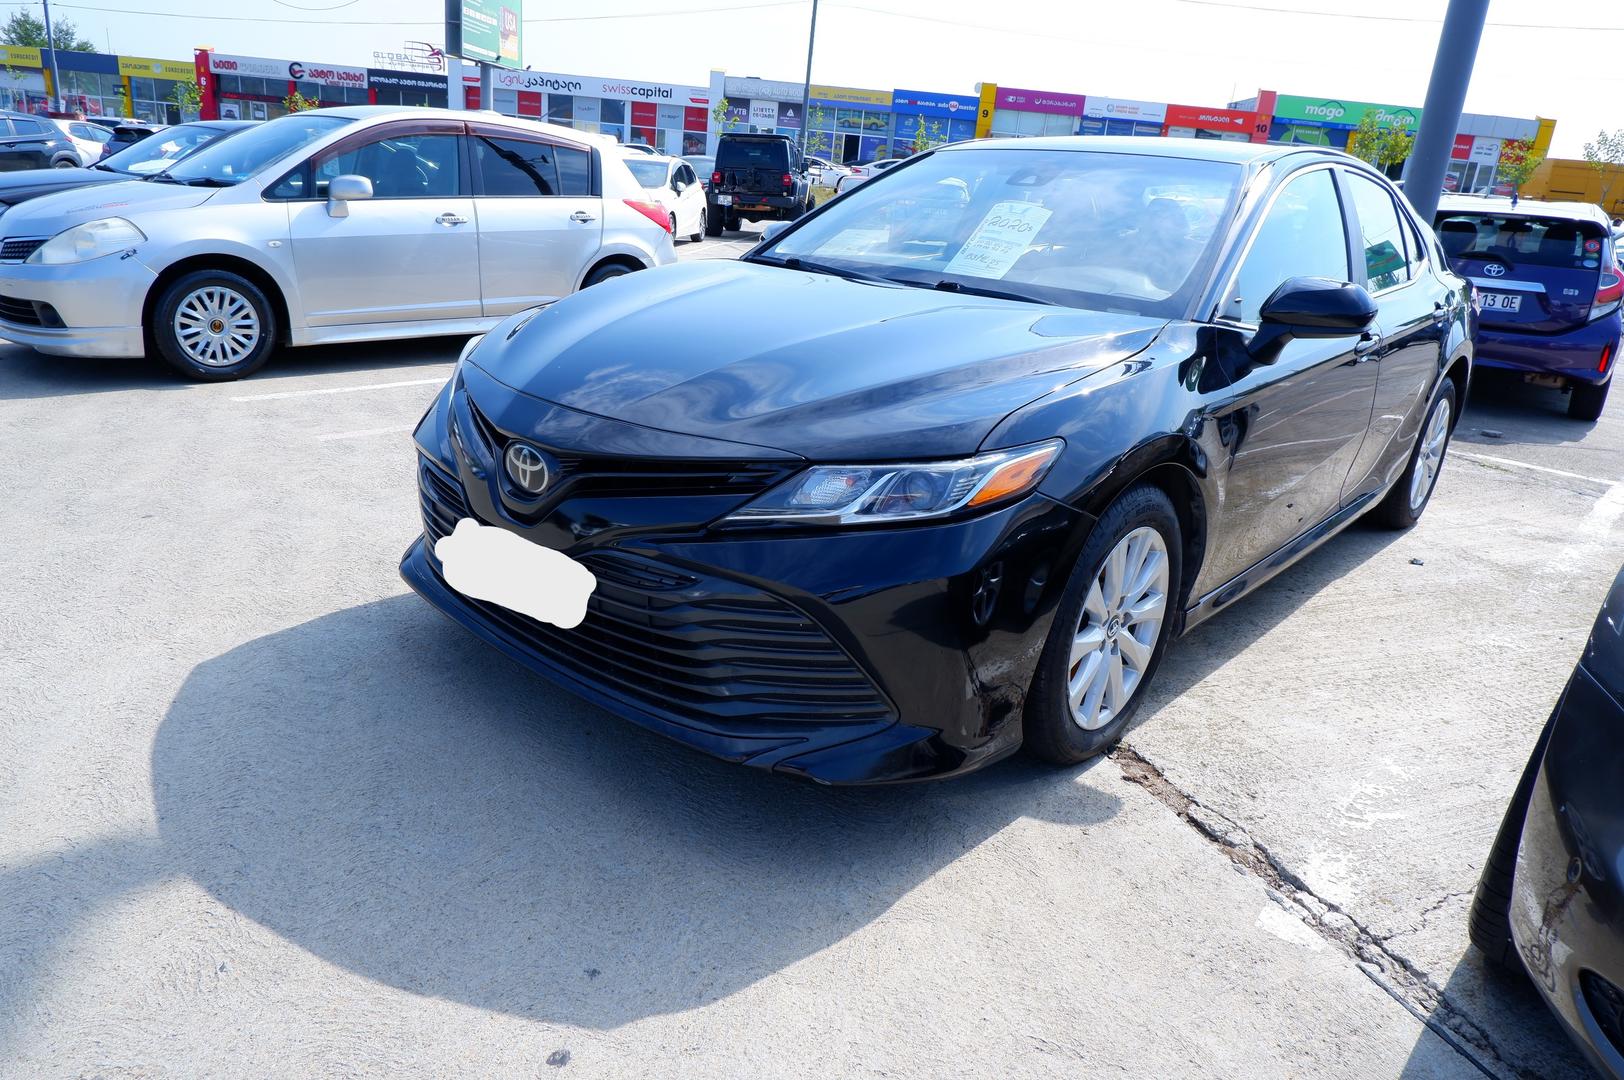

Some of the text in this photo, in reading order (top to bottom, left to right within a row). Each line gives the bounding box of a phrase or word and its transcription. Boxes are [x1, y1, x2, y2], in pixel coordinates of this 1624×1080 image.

[373, 51, 416, 62] GLOBAL
[308, 69, 365, 83] ავტო სესხი
[200, 77, 207, 86] 6
[602, 83, 673, 99] swisscapital
[733, 107, 747, 116] VTB
[982, 109, 989, 118] 9
[1304, 104, 1345, 120] mogo
[1255, 124, 1267, 133] 10
